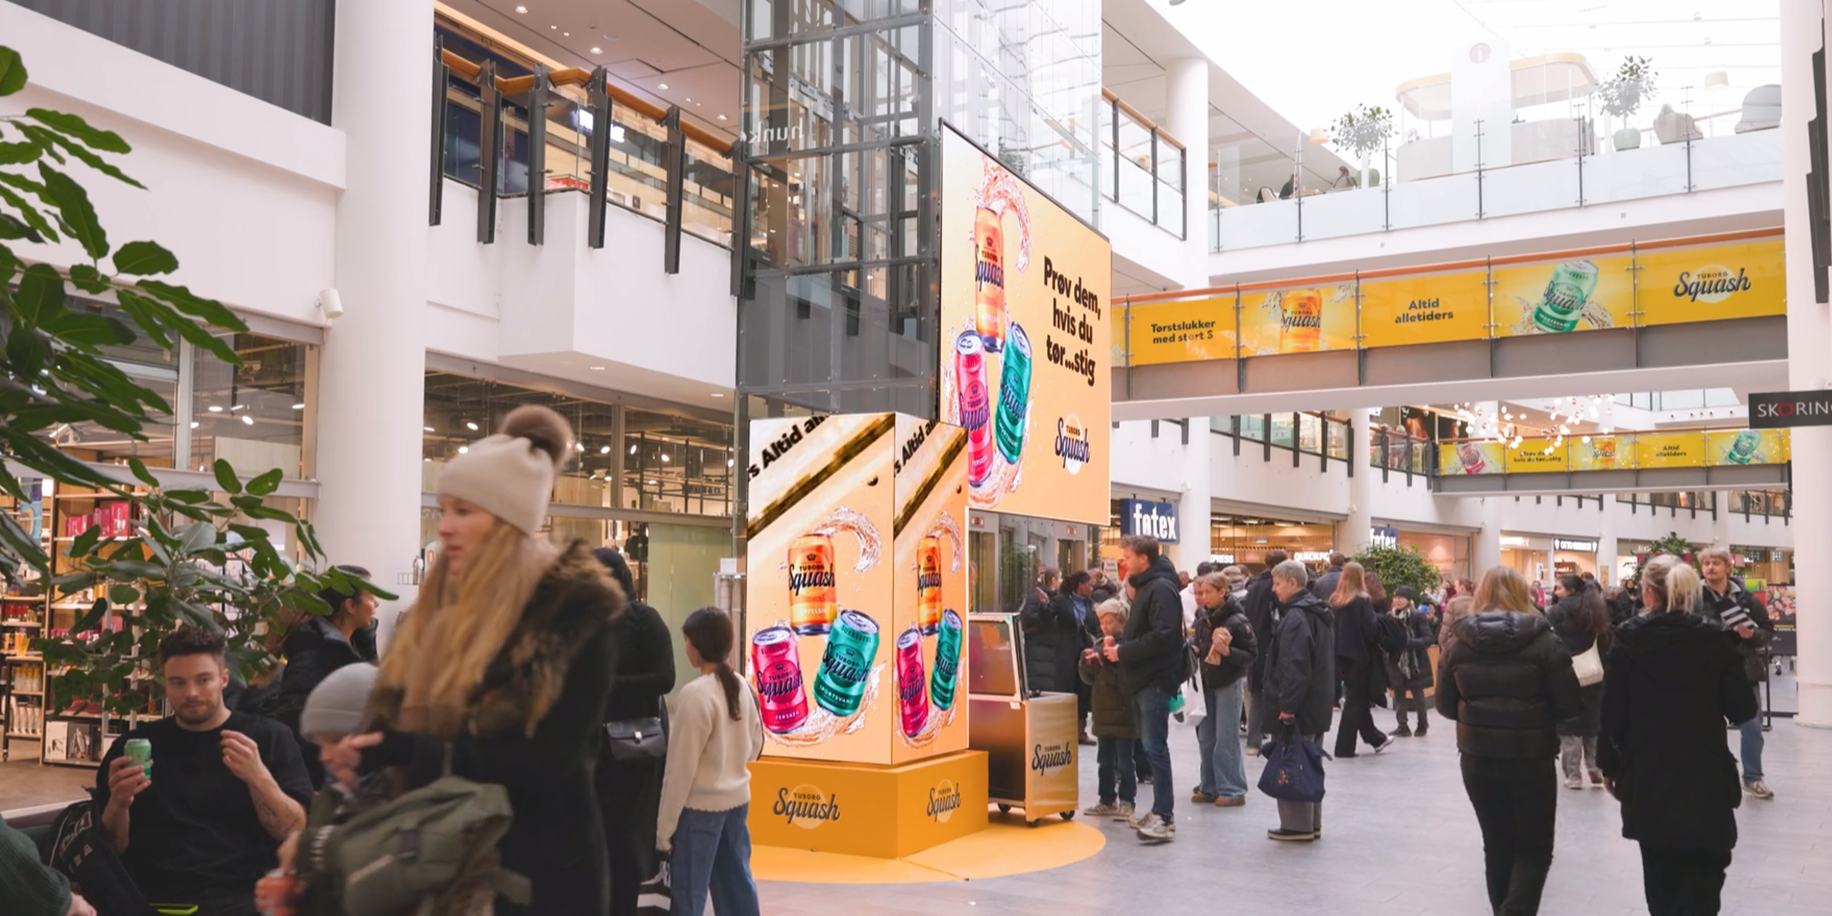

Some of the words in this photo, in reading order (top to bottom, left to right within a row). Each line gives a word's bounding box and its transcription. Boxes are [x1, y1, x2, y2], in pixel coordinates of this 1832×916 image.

[1044, 255, 1072, 299] Prøv
[1074, 276, 1101, 321] dem,
[1673, 267, 1752, 303] Squash
[1697, 271, 1728, 279] TUBORG
[1408, 298, 1439, 311] Altid
[1544, 280, 1589, 311] Squash
[1053, 297, 1076, 336] hvis
[1079, 313, 1093, 345] du
[1150, 319, 1216, 333] Tørstslukker
[1281, 308, 1321, 334] Squash
[1395, 311, 1454, 324] alletiders
[1153, 333, 1175, 344] med
[1046, 334, 1096, 387] tør...stig
[1758, 400, 1832, 418] SKORIN
[762, 424, 803, 469] Altid
[902, 425, 925, 466] Altid
[1055, 416, 1091, 469] Squash
[789, 562, 836, 597] Squash
[768, 670, 793, 680] TUBORG
[822, 641, 872, 684] Squash
[835, 652, 860, 668] TUBORG
[757, 662, 803, 703] Squash
[1031, 741, 1073, 777] Squash
[772, 787, 841, 825] Squash
[793, 792, 821, 800] TUBORG
[926, 782, 962, 822] Squash
